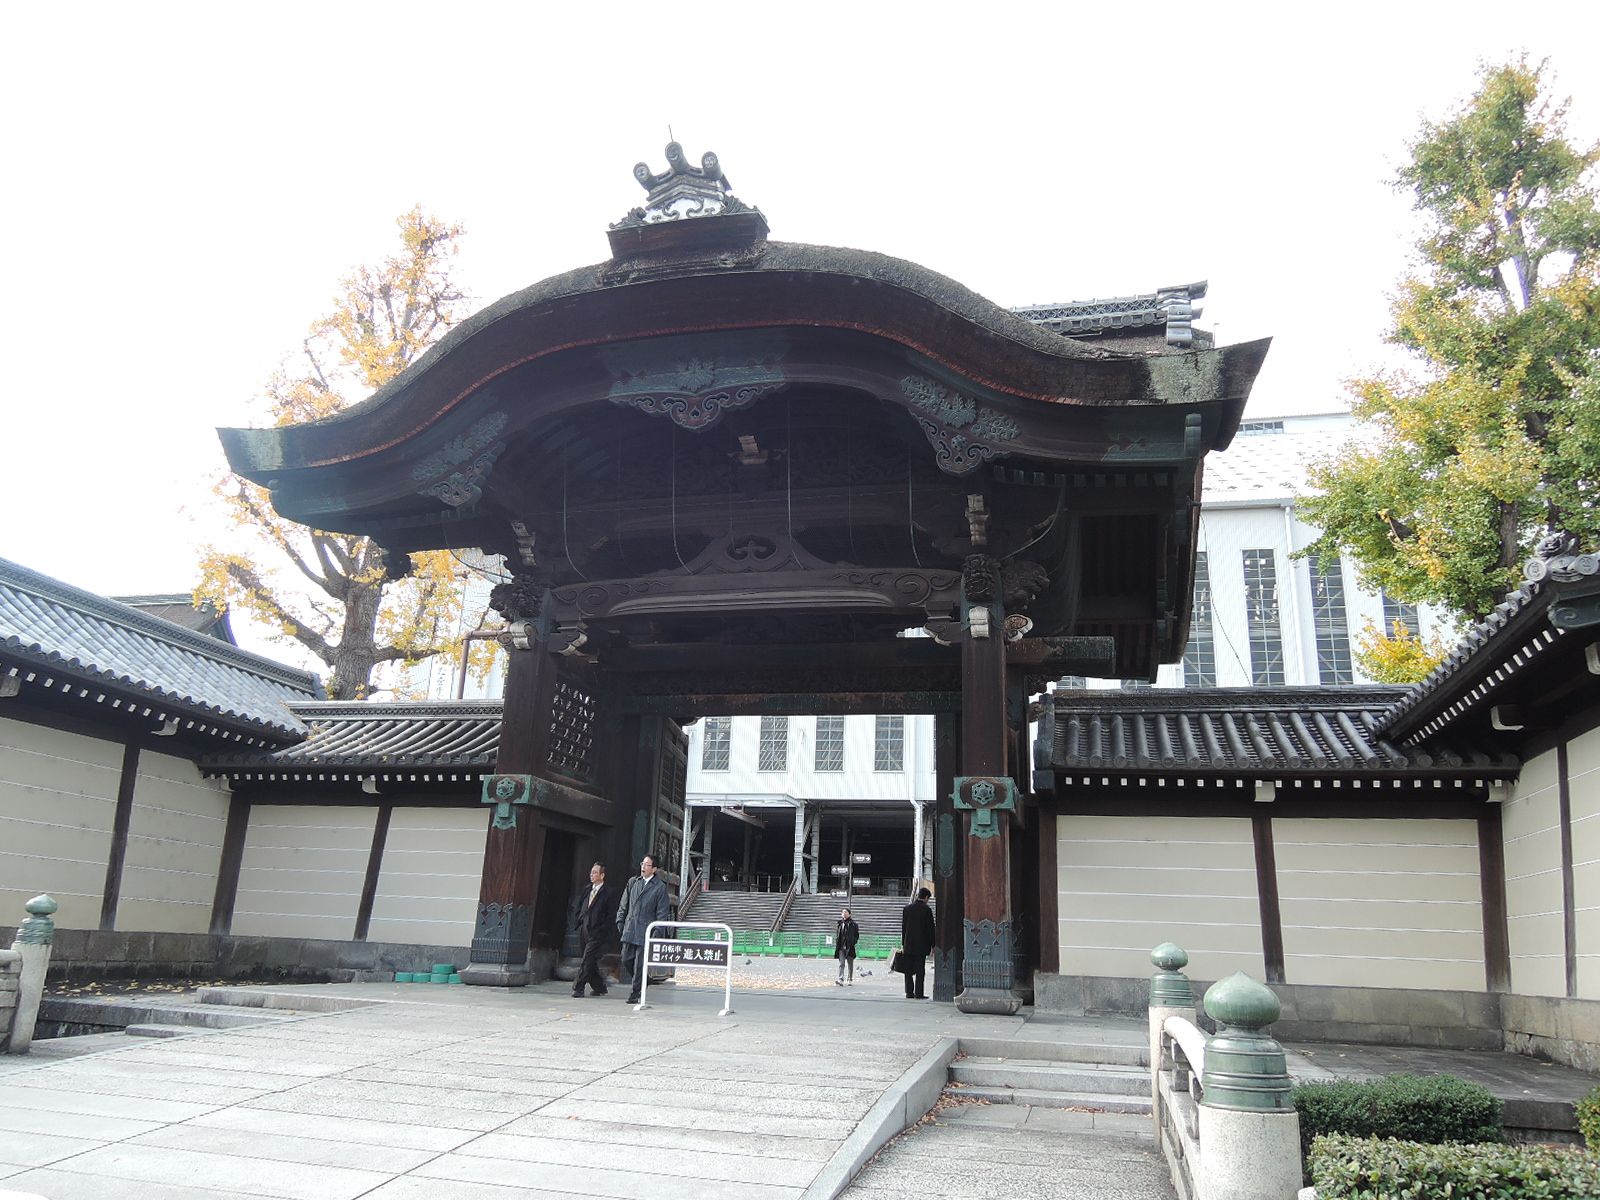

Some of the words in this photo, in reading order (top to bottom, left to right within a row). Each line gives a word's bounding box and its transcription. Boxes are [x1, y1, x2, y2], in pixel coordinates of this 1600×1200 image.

[662, 944, 682, 953] 自転車
[661, 954, 681, 962] バイク
[683, 949, 723, 961] 進入禁止
